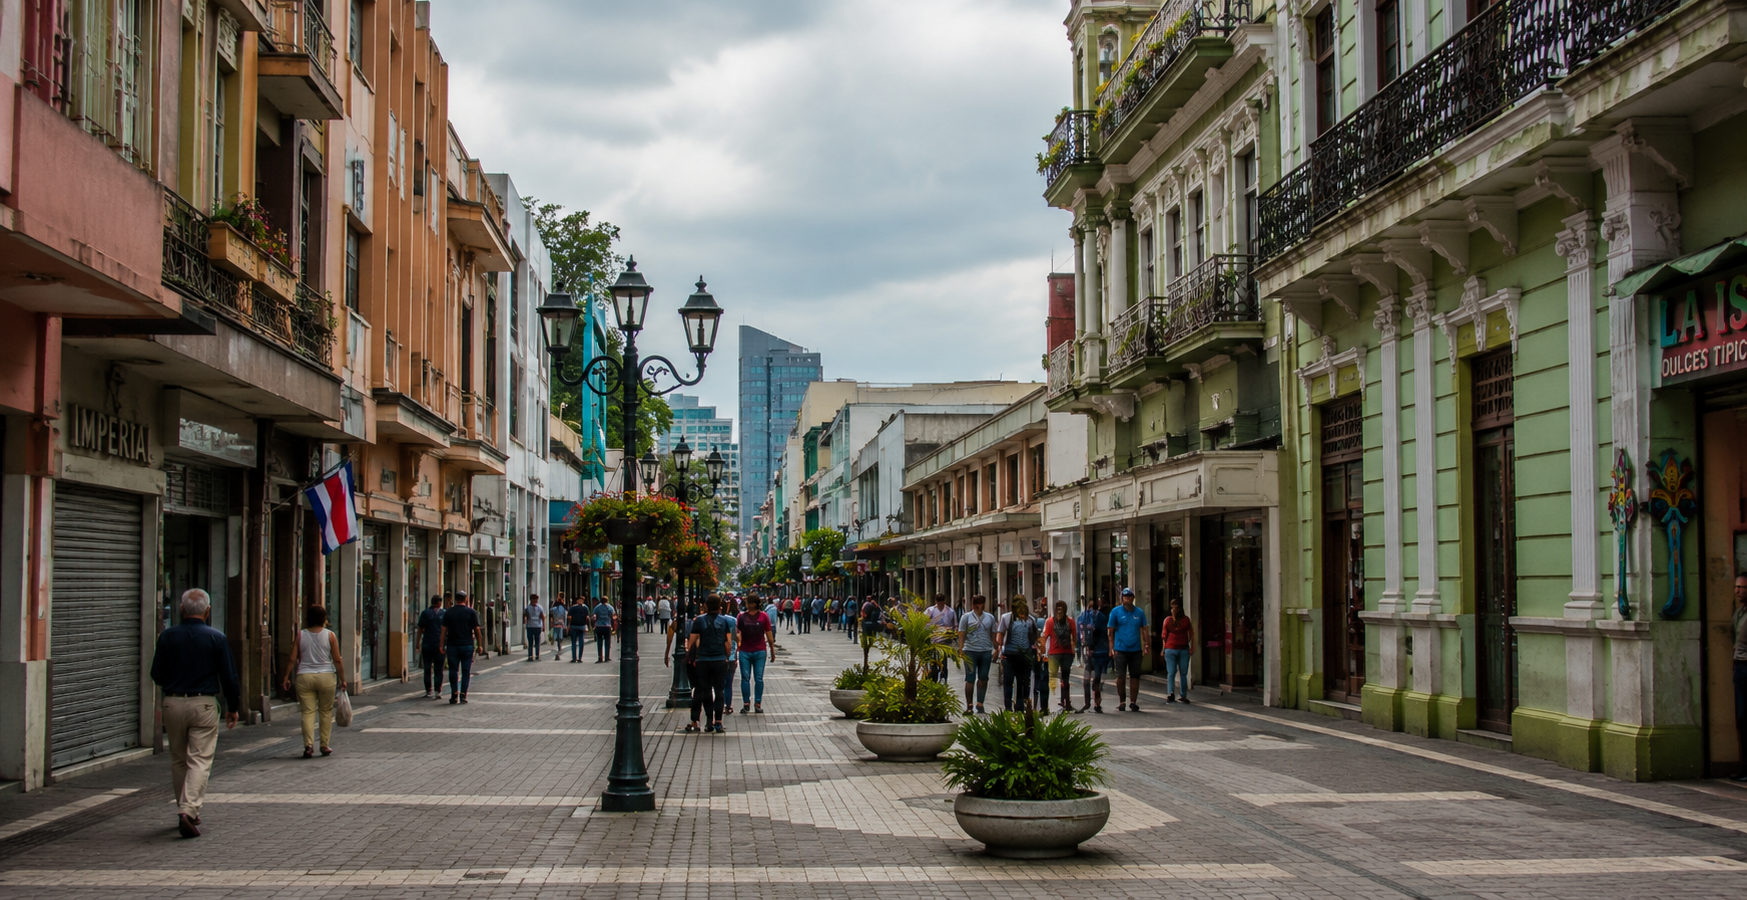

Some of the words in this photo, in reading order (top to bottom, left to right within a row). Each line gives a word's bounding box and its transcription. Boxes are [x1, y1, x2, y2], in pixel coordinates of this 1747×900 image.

[1660, 290, 1704, 348] LA
[1715, 275, 1747, 334] IS
[1662, 348, 1709, 377] DULCES
[75, 404, 152, 466] IMPERIAL
